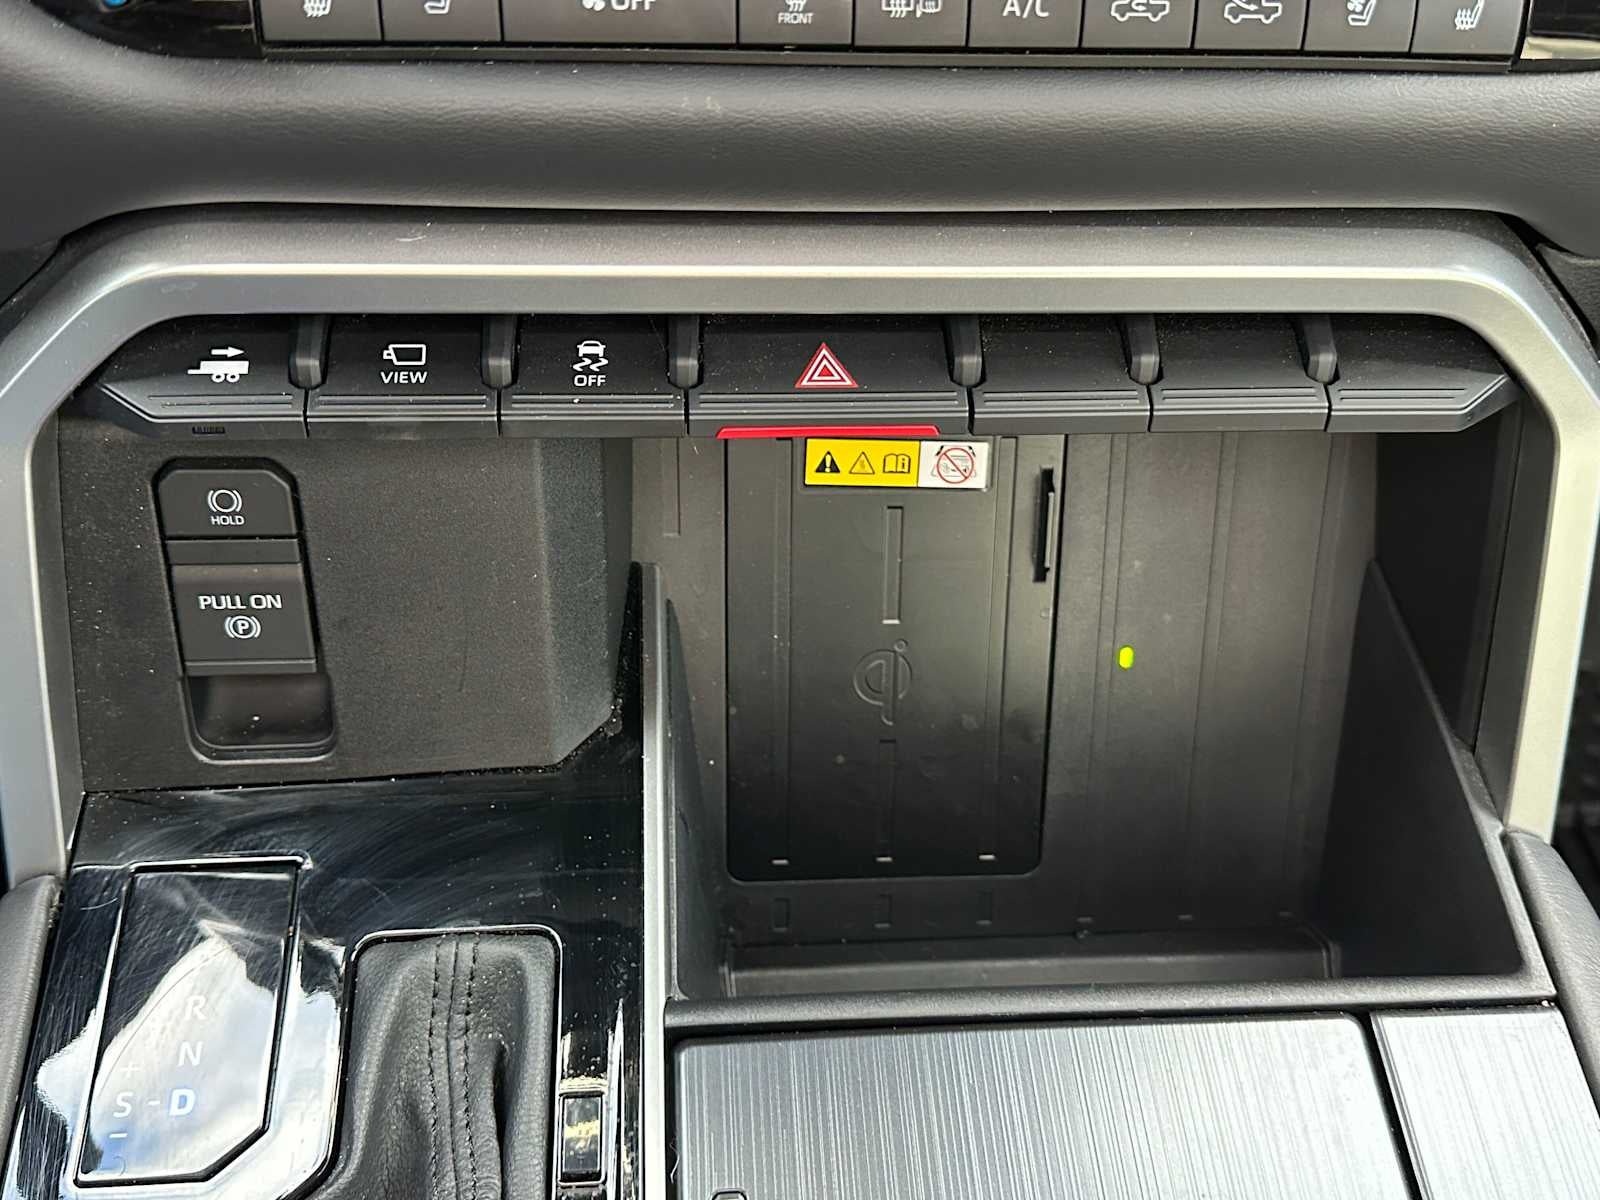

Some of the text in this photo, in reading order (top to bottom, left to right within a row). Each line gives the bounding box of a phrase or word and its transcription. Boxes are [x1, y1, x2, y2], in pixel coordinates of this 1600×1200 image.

[1002, 0, 1050, 19] A/C
[777, 12, 814, 25] FRONT
[380, 371, 428, 385] VIEW
[573, 374, 607, 388] OFF
[210, 515, 246, 526] HOLD
[198, 594, 283, 610] PULL ON
[186, 996, 208, 1021] R
[179, 1042, 203, 1066] N
[169, 1089, 196, 1116] D
